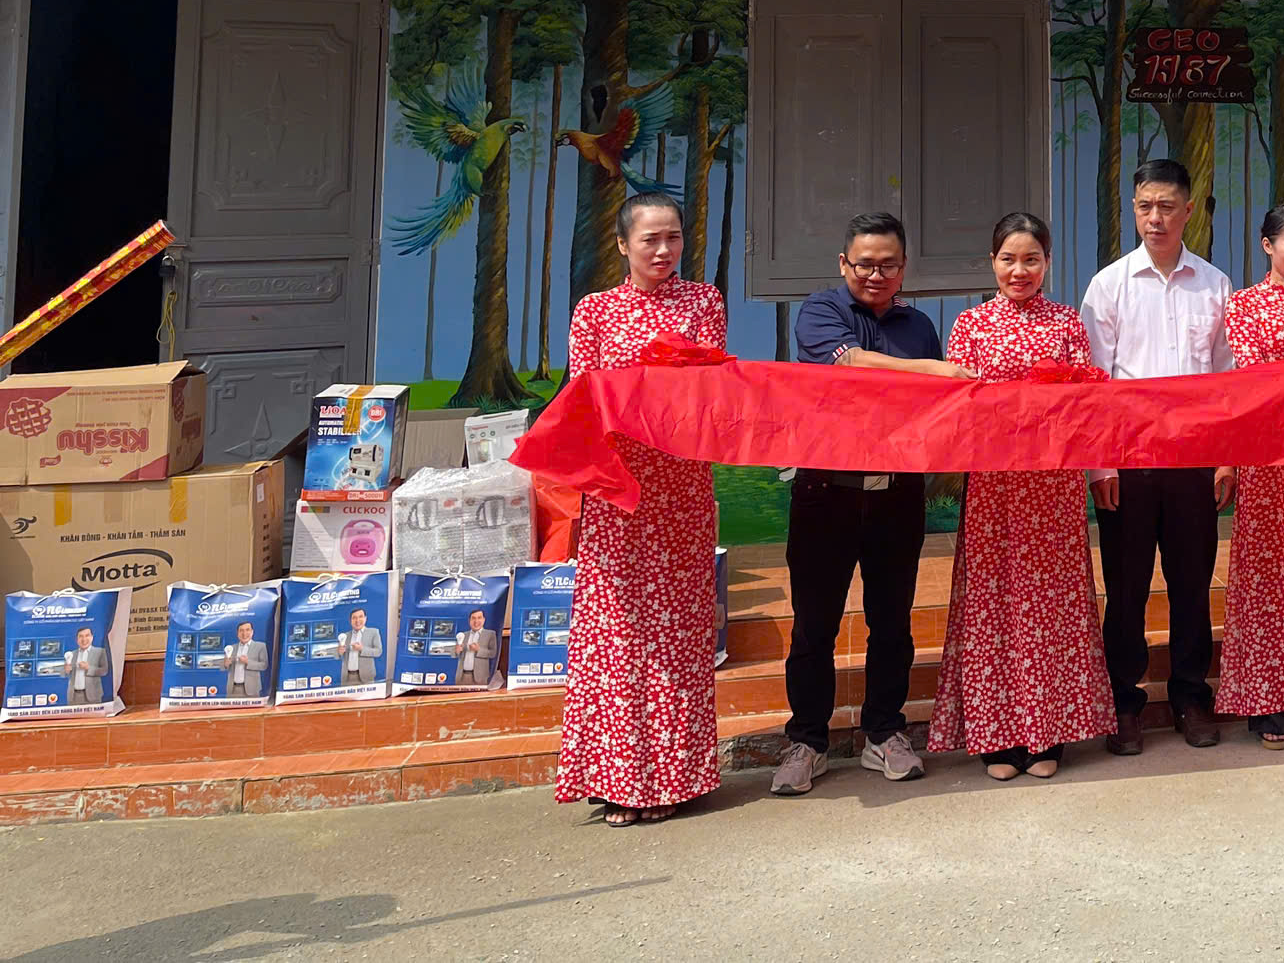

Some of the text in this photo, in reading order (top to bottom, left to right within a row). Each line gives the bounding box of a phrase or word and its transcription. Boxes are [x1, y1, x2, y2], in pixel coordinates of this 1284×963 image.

[1144, 53, 1232, 86] 1987
[1128, 86, 1182, 104] Successful
[56, 427, 149, 455] Kisshu
[343, 506, 386, 514] CUCKOO
[81, 563, 158, 583] Motta
